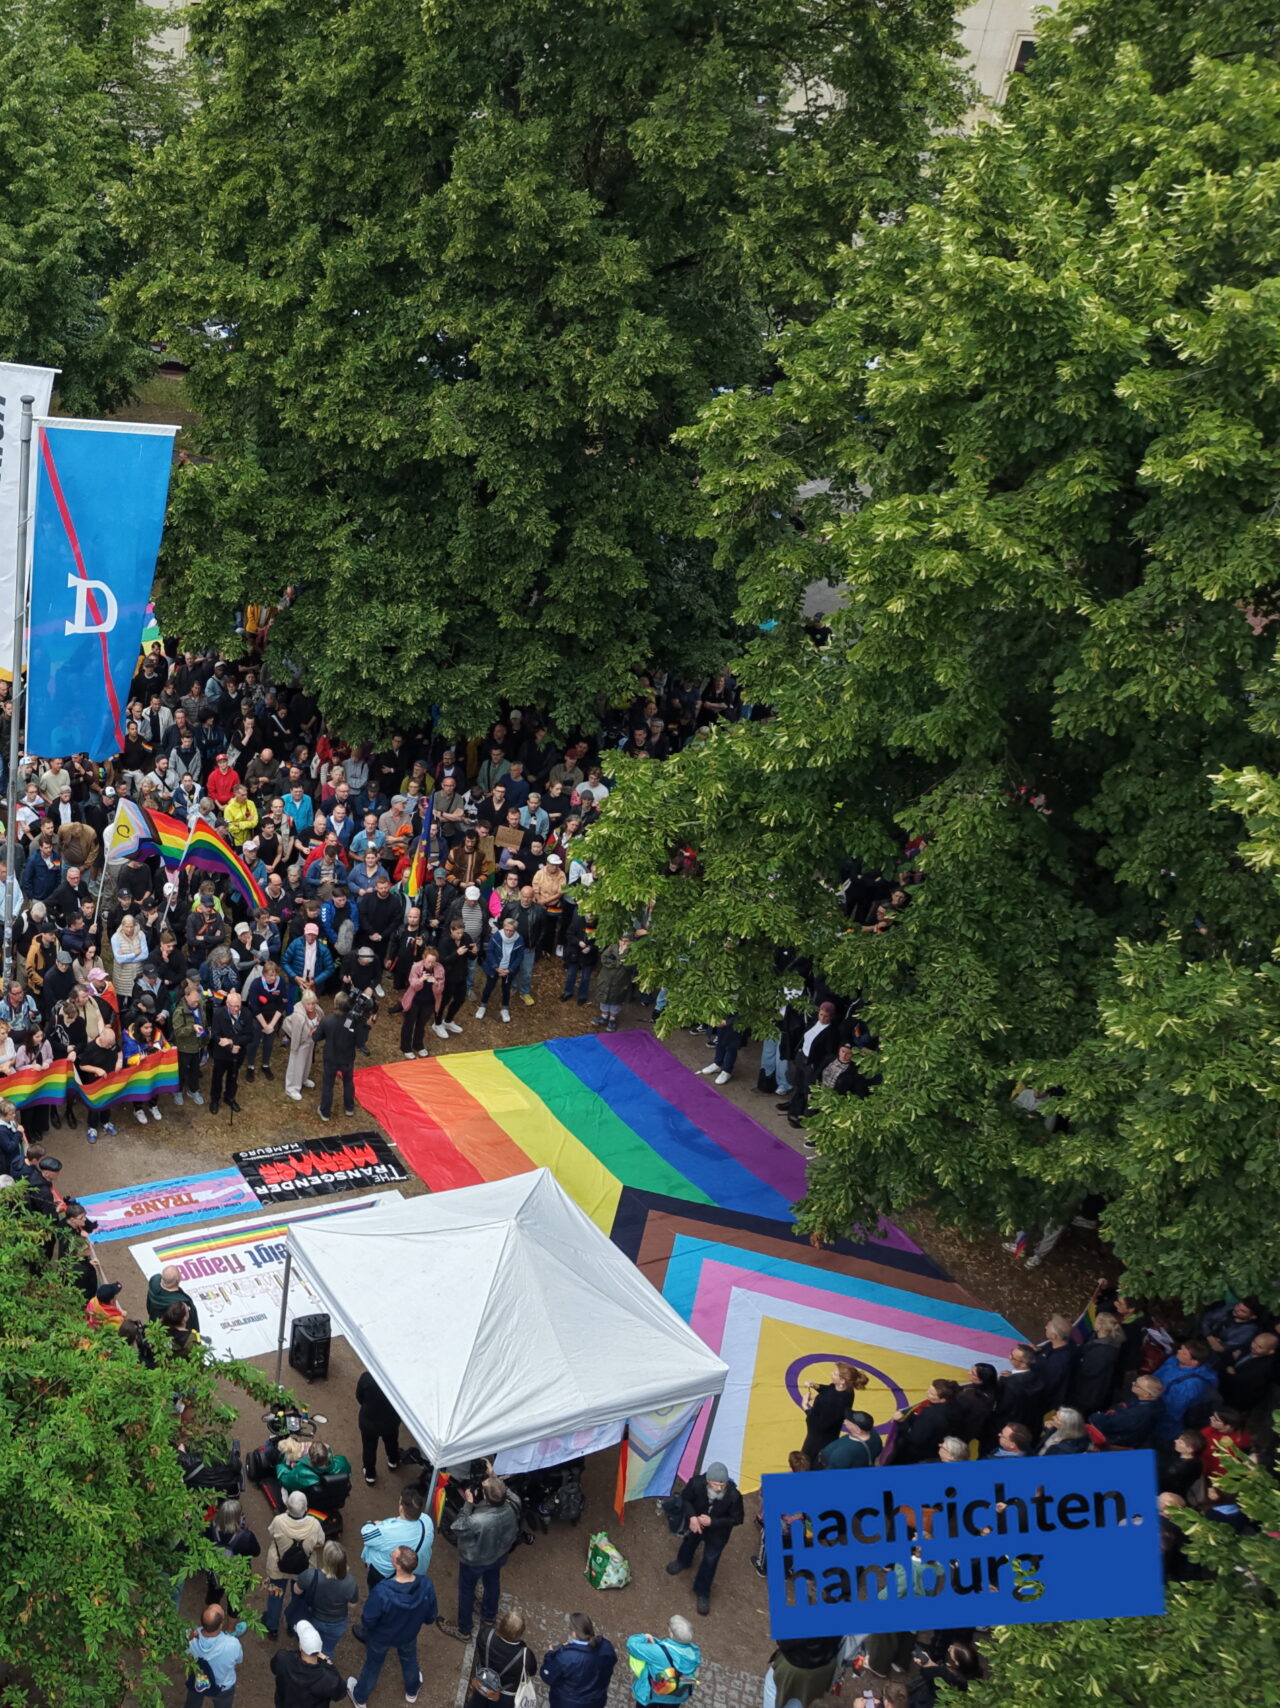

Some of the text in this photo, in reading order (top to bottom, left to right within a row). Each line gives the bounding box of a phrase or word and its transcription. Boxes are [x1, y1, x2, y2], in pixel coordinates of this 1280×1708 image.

[238, 1142, 300, 1158] HAMBURG
[258, 1143, 379, 1184] MENACE
[244, 1241, 290, 1268] eigt
